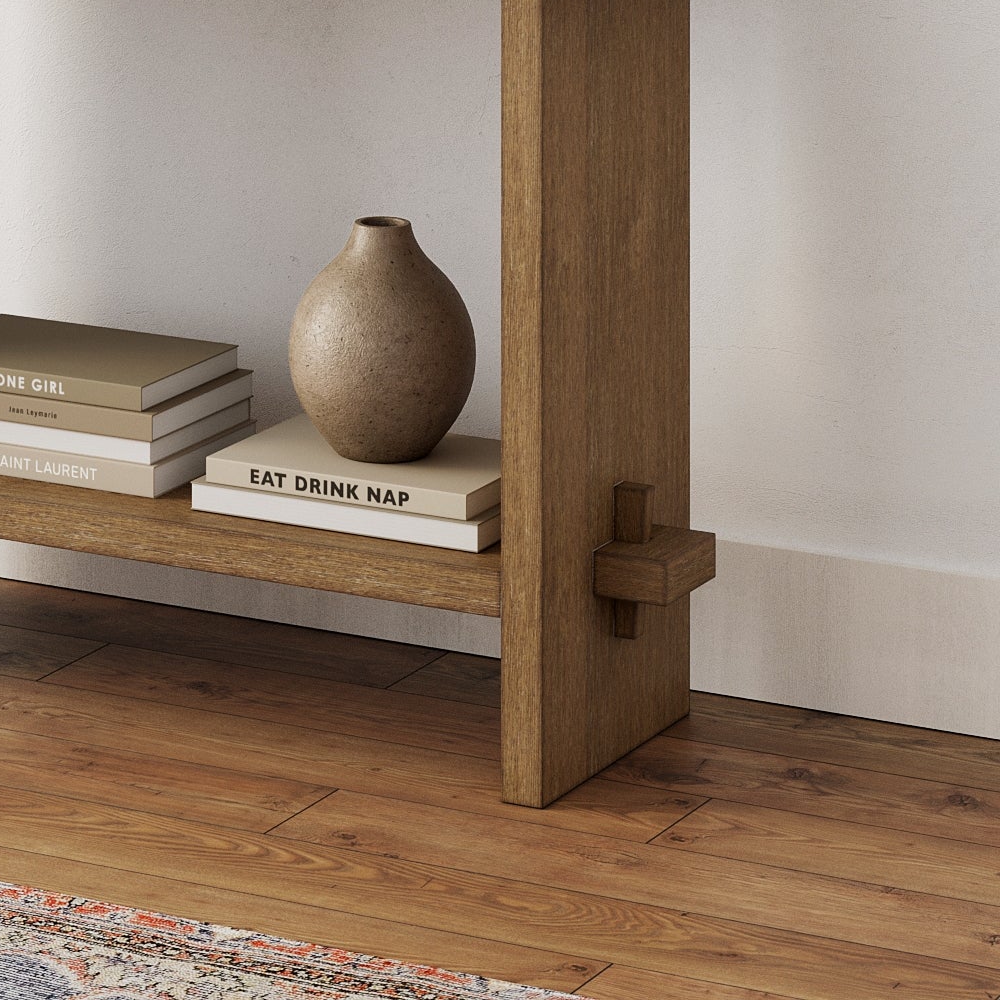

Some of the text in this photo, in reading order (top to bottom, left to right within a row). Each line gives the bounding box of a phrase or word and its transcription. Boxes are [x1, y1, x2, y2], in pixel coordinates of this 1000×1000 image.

[31, 378, 65, 396] GIRL
[8, 405, 24, 415] Jean
[35, 459, 98, 480] LAURENT
[250, 468, 410, 507] EAT DRINK NAP
